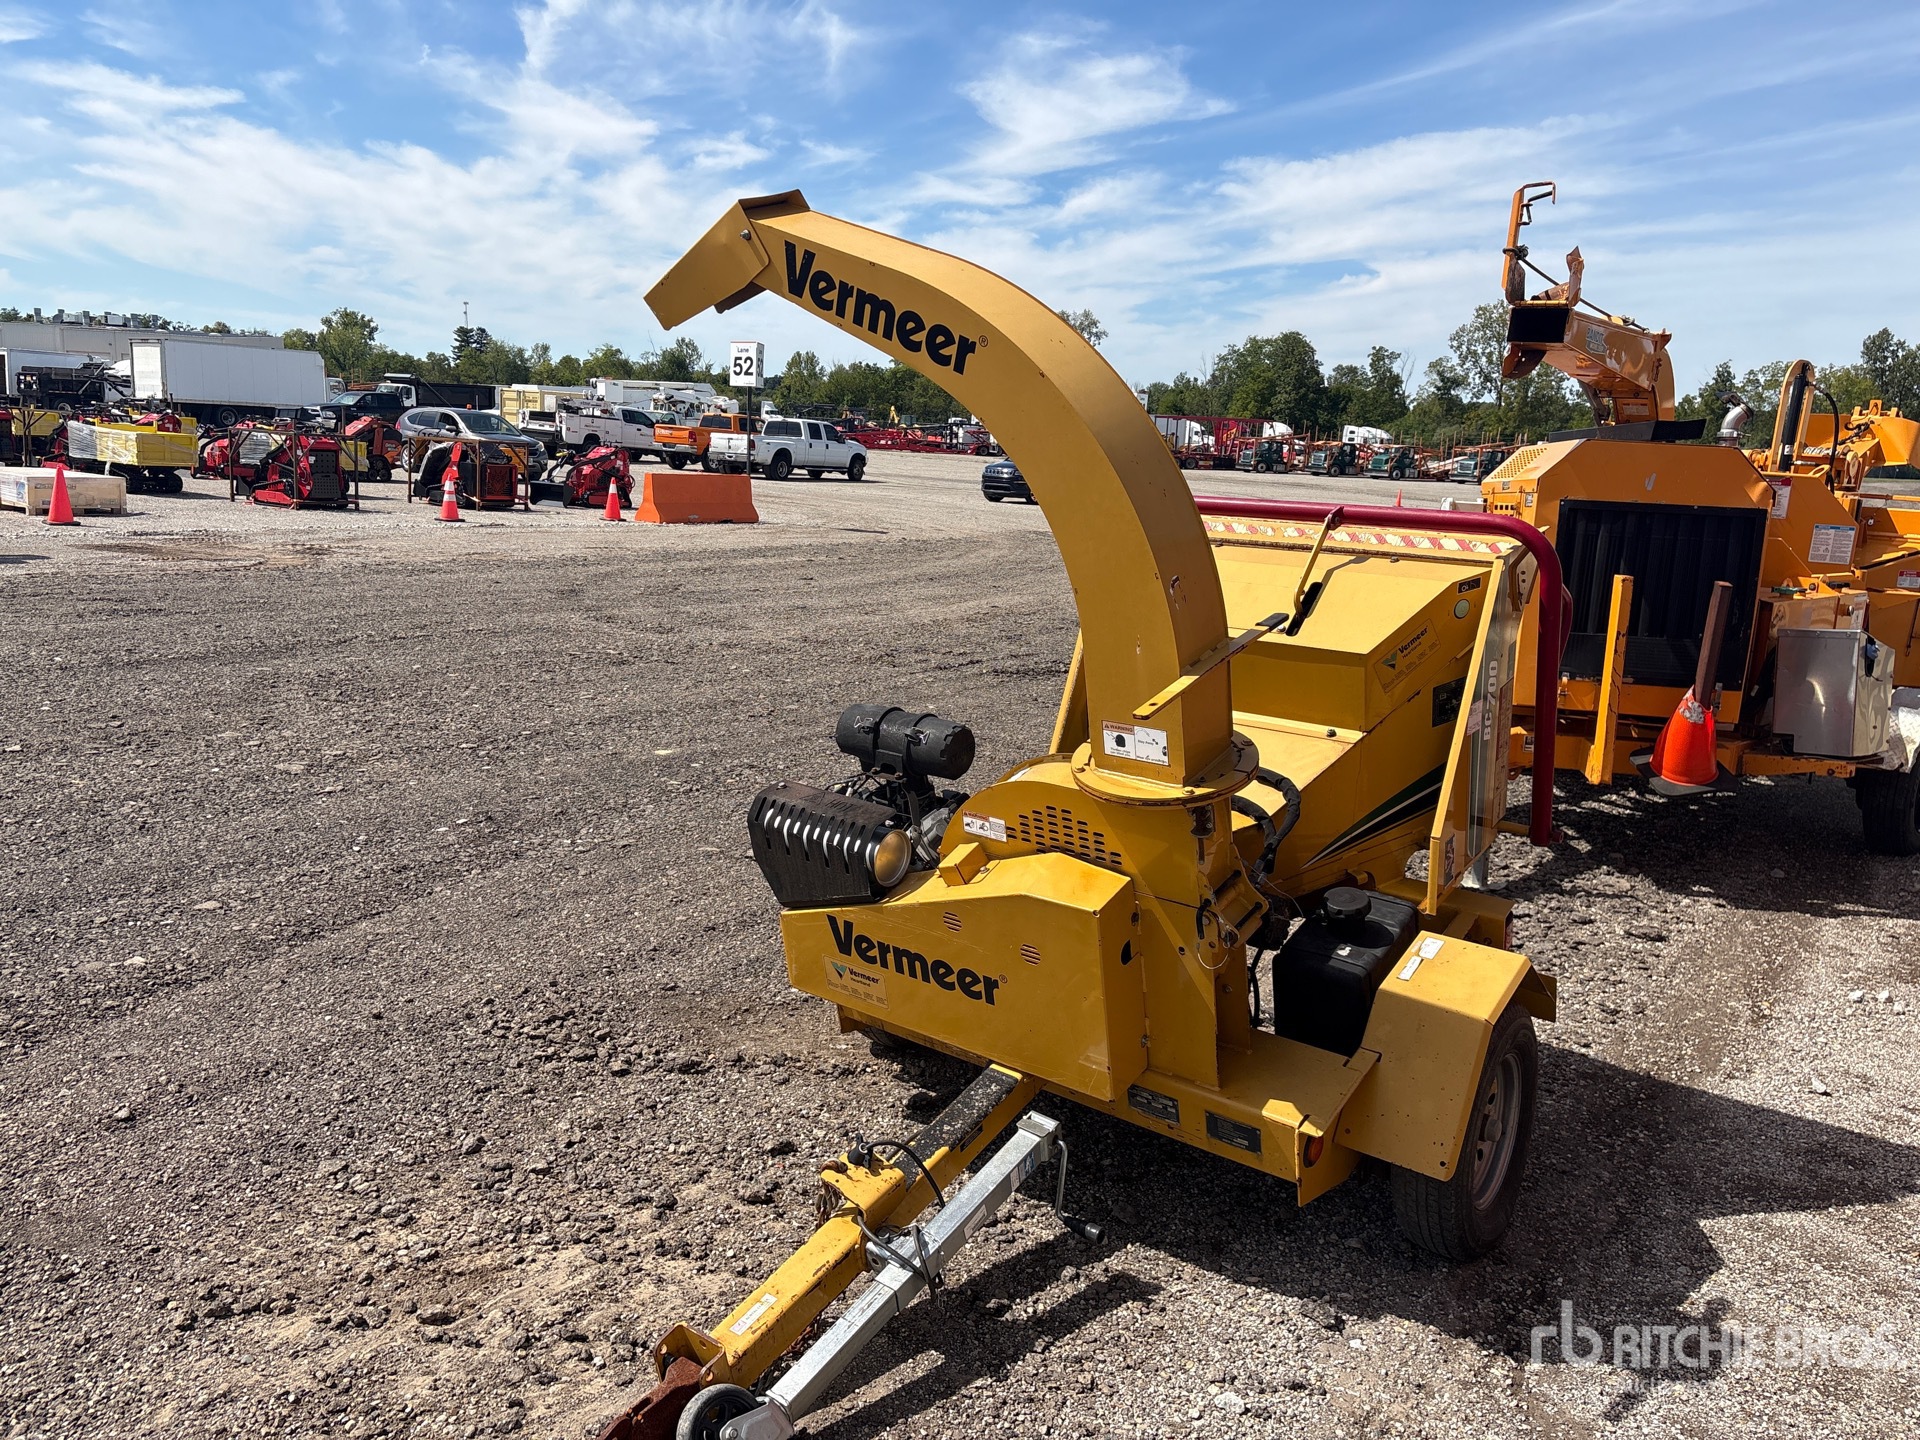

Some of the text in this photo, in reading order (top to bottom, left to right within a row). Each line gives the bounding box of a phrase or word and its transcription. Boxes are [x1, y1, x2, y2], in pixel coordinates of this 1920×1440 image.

[733, 356, 754, 376] 52
[1398, 626, 1428, 654] Vermeer
[1486, 660, 1498, 709] 700
[1110, 724, 1133, 732] WARNING
[825, 799, 855, 812] HOT
[848, 966, 880, 984] Vermeer
